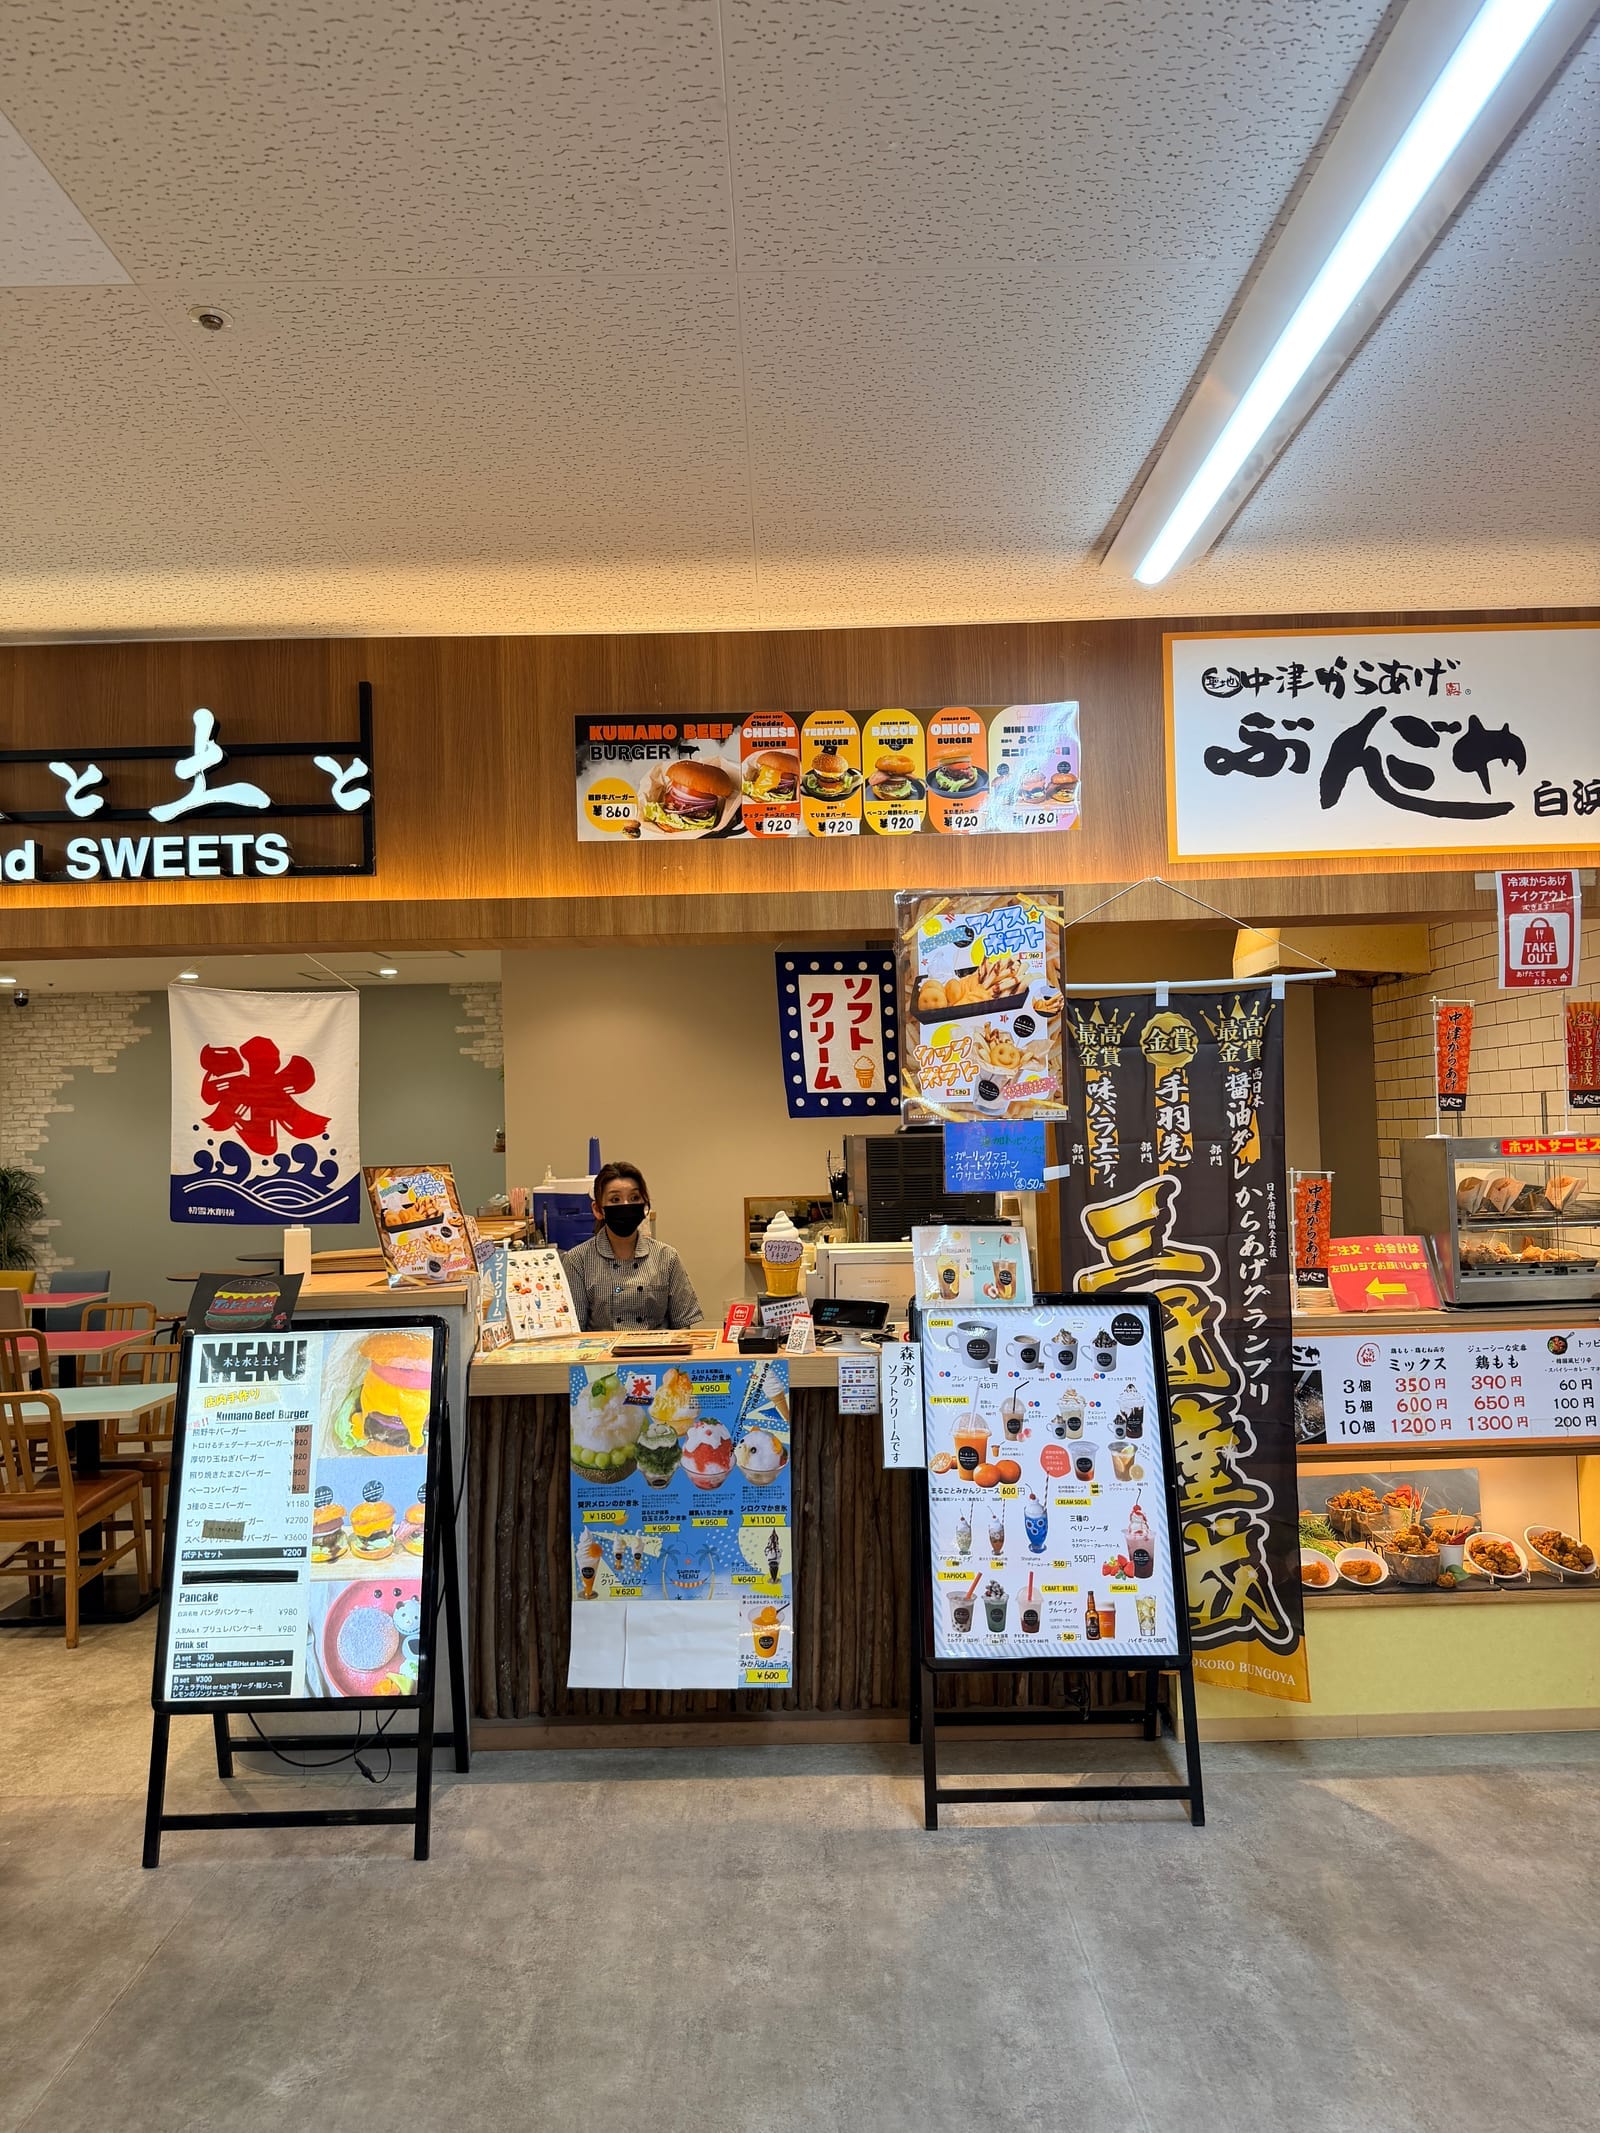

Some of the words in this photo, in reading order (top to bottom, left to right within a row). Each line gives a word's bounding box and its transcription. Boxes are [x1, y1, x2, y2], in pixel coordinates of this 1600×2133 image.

[589, 724, 677, 741] KUMANO
[681, 723, 734, 740] BEEF
[743, 726, 796, 739] CHEESE
[804, 727, 857, 737] TERITAMA
[871, 725, 918, 737] BACON
[930, 723, 981, 736] ONION
[1003, 726, 1025, 734] MINI
[878, 738, 914, 746] BURGER
[590, 744, 671, 761] BURGER
[1204, 706, 1527, 820] ぶんごや
[66, 832, 290, 880] SWEETS
[1507, 875, 1567, 887] 冷凍からあげ
[1509, 890, 1567, 903] テイクアウト
[984, 927, 1044, 956] ポテト
[1525, 942, 1555, 953] TAKE
[1527, 953, 1553, 964] OUT
[844, 977, 874, 1051] ソフト
[1077, 1023, 1122, 1045] 最高
[1218, 1017, 1264, 1041] 最高
[807, 993, 842, 1089] クリーム
[1146, 1028, 1195, 1053] 金賞
[1079, 1045, 1122, 1067] 金賞
[1219, 1041, 1263, 1063] 金賞
[1445, 1011, 1463, 1092] 中津からあげ
[200, 1036, 332, 1156] 氷
[1252, 1067, 1265, 1107] 西日本
[1155, 1074, 1192, 1162] 手羽先
[1087, 1077, 1119, 1188] 味バラエティ
[1072, 1143, 1084, 1166] 部門
[1140, 1141, 1153, 1164] 部門
[1210, 1143, 1223, 1167] 部門
[1305, 1185, 1323, 1266] 中津からあげ
[493, 1253, 504, 1317] ソフトクリーム
[1234, 1187, 1271, 1405] からあげグランプリ
[223, 1356, 280, 1367] 木と水と土と
[900, 1346, 915, 1387] 森永の
[1389, 1357, 1447, 1372] ミックス
[1475, 1355, 1519, 1370] 鶏もも
[632, 1378, 651, 1396] 氷
[1343, 1378, 1372, 1394] 3個
[1395, 1377, 1446, 1393] 350円
[1471, 1375, 1522, 1390] 390円
[1559, 1378, 1593, 1391] 60円
[1345, 1399, 1373, 1414] 5個
[1397, 1397, 1448, 1413] 600円
[1474, 1395, 1525, 1410] 650円
[1554, 1397, 1595, 1409] 100円
[216, 1411, 252, 1421] Kumano
[255, 1410, 275, 1420] Beef
[278, 1409, 309, 1421] Burger
[888, 1365, 901, 1464] ソフトクリームです
[1339, 1420, 1376, 1435] 10個
[1391, 1418, 1452, 1434] 1200円
[1468, 1415, 1529, 1431] 1300円
[1554, 1416, 1598, 1428] 200円
[590, 1512, 616, 1520] ¥1800
[740, 1504, 787, 1512] シロクマかき氷
[750, 1516, 776, 1524] ¥1100
[182, 1550, 223, 1559] ポテトセット
[282, 1548, 302, 1557] ¥200
[1074, 1554, 1095, 1563] 550円
[601, 1578, 648, 1586] クリームパフェ
[179, 1592, 219, 1603] Pancake
[279, 1608, 298, 1616] ¥980
[278, 1625, 297, 1633] ¥980
[175, 1641, 194, 1649] Drink
[197, 1641, 208, 1649] set
[757, 1671, 779, 1680] ¥600
[1239, 1662, 1296, 1686] BUNGOYA
